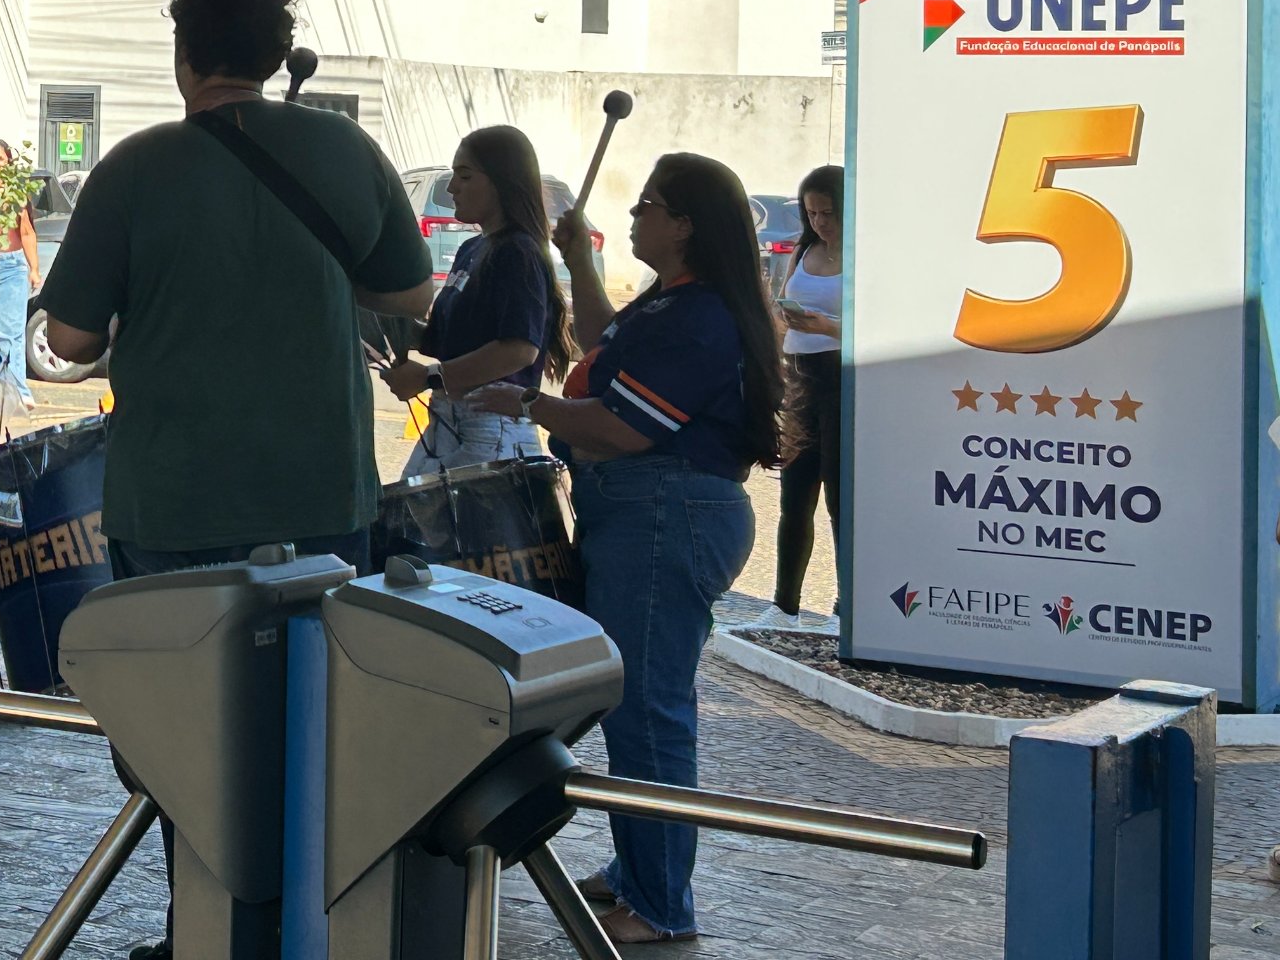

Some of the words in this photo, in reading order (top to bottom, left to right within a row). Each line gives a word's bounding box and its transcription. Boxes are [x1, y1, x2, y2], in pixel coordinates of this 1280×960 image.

[959, 40, 1019, 54] Fundação
[1022, 40, 1097, 51] Educacional
[1100, 40, 1115, 51] de
[1119, 40, 1181, 54] Penápolis
[953, 103, 1145, 354] 5
[962, 434, 1132, 468] CONCEITO
[934, 465, 1162, 524] MÁXIMO
[977, 520, 1025, 546] NO
[1035, 525, 1106, 553] MEC
[929, 586, 1031, 618] FAFIPE
[1088, 604, 1212, 642] CENEP
